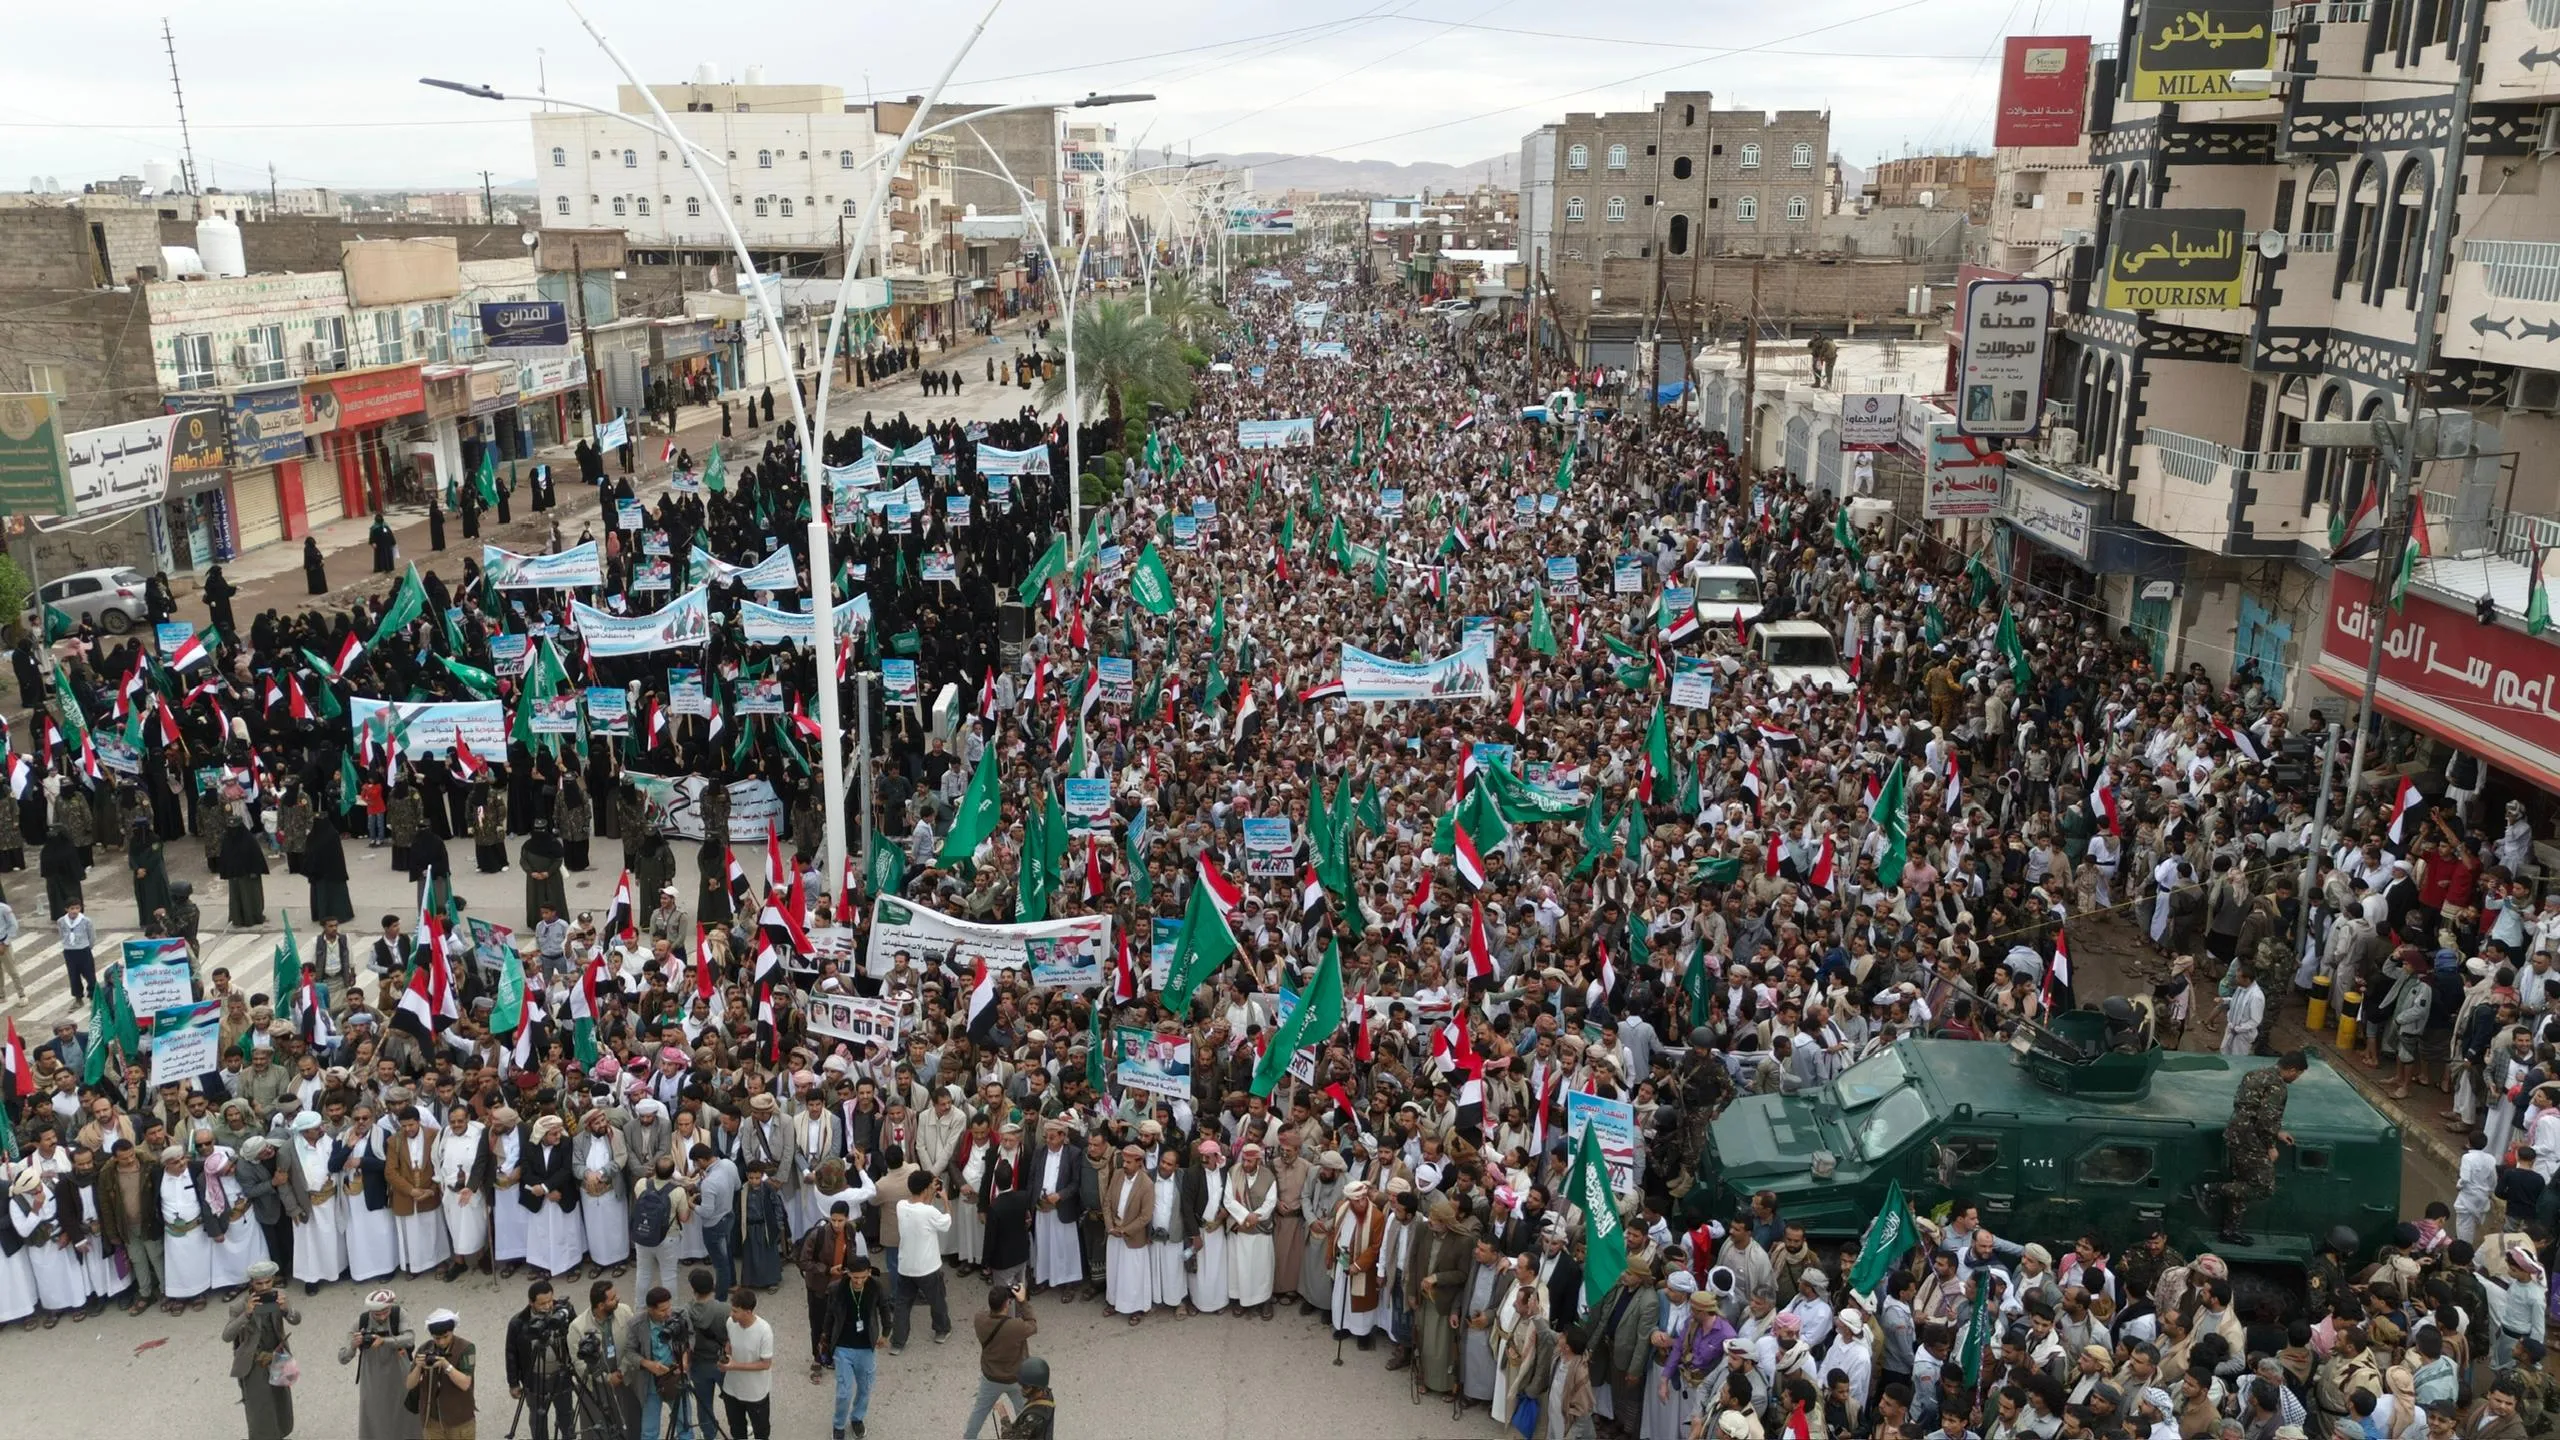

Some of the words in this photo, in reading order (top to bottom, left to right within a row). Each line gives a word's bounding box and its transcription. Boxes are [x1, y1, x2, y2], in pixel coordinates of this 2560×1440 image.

[2150, 10, 2264, 51] ميلانو
[2158, 75, 2234, 95] MILAN
[2121, 229, 2233, 273] السياحي
[1994, 290, 2028, 306] مركز
[2124, 287, 2228, 305] TOURISM
[1979, 312, 2036, 329] هدنة
[1976, 341, 2036, 358] للجوالات
[1879, 412, 1897, 425] أمير
[68, 444, 96, 468] اسط
[100, 429, 162, 468] مخابز
[76, 479, 107, 500] الح
[1931, 474, 1998, 497] والسلام
[2337, 601, 2426, 663] الماق
[2424, 641, 2492, 688] سر
[2493, 668, 2560, 722] اعم
